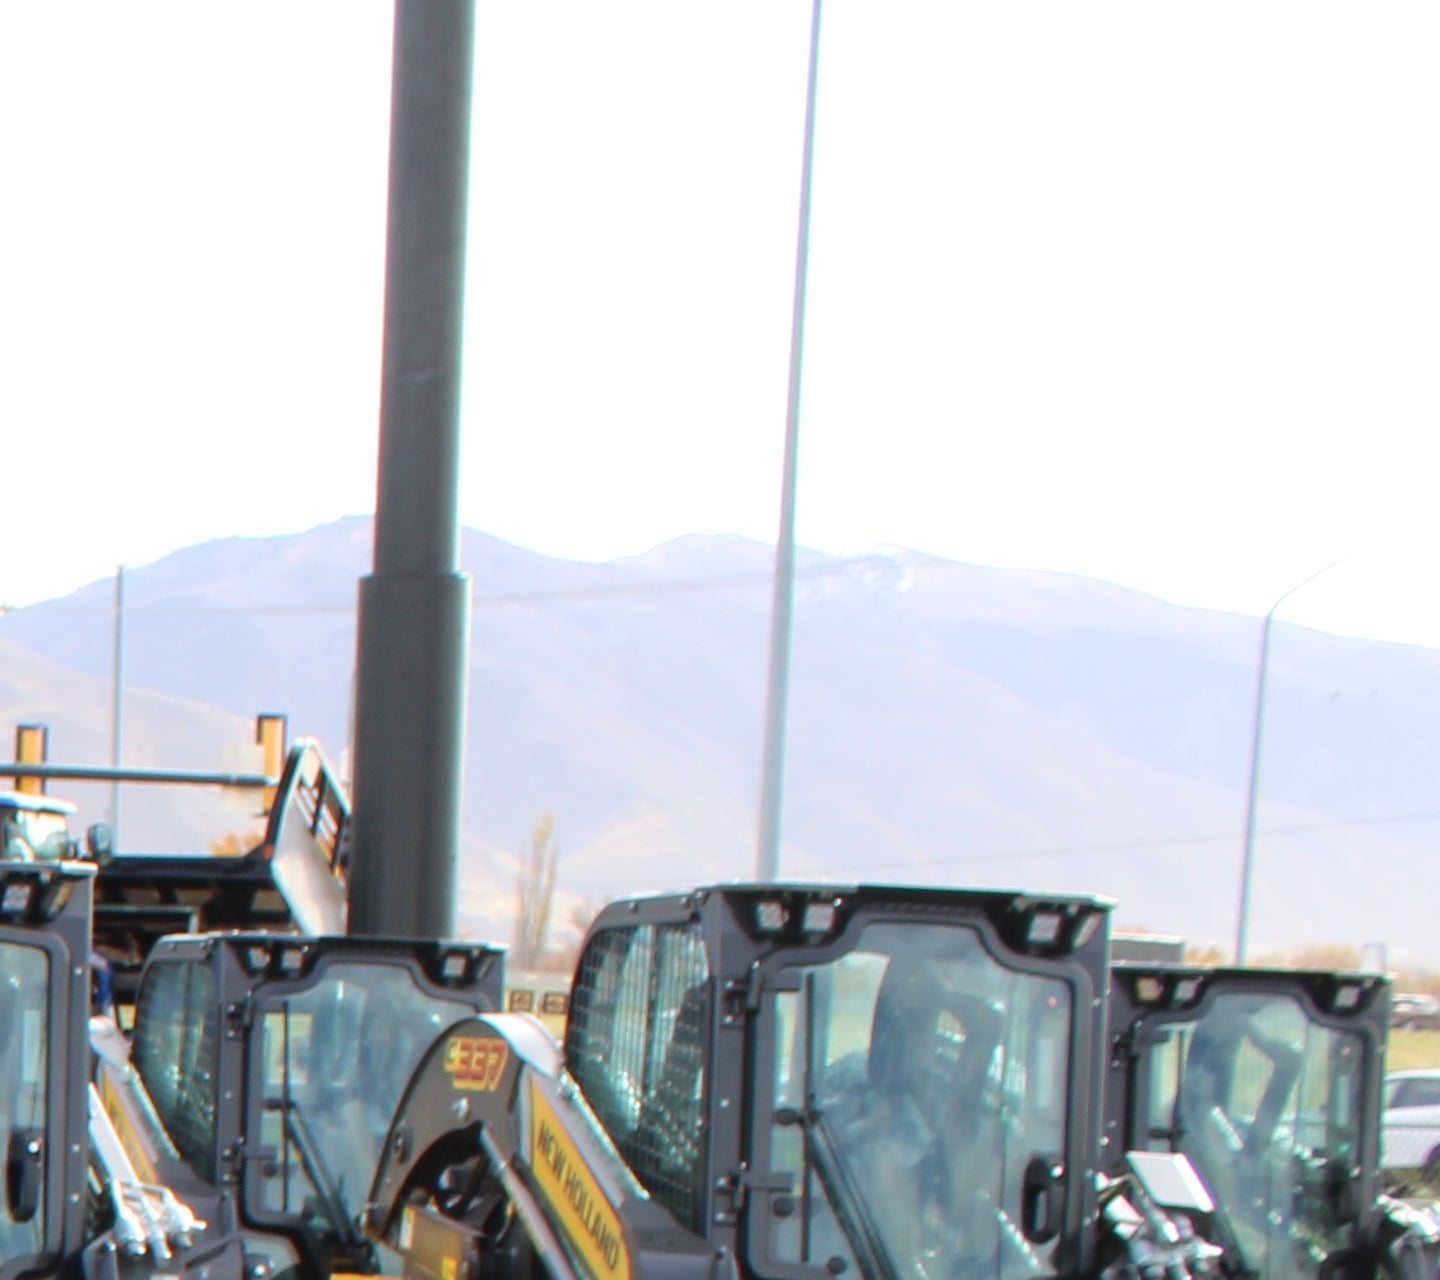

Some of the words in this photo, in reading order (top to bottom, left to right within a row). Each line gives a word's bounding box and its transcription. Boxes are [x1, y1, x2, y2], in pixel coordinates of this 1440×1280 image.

[444, 1037, 510, 1091] C337
[538, 1119, 568, 1183] NEW
[565, 1164, 621, 1272] HOLLAND
